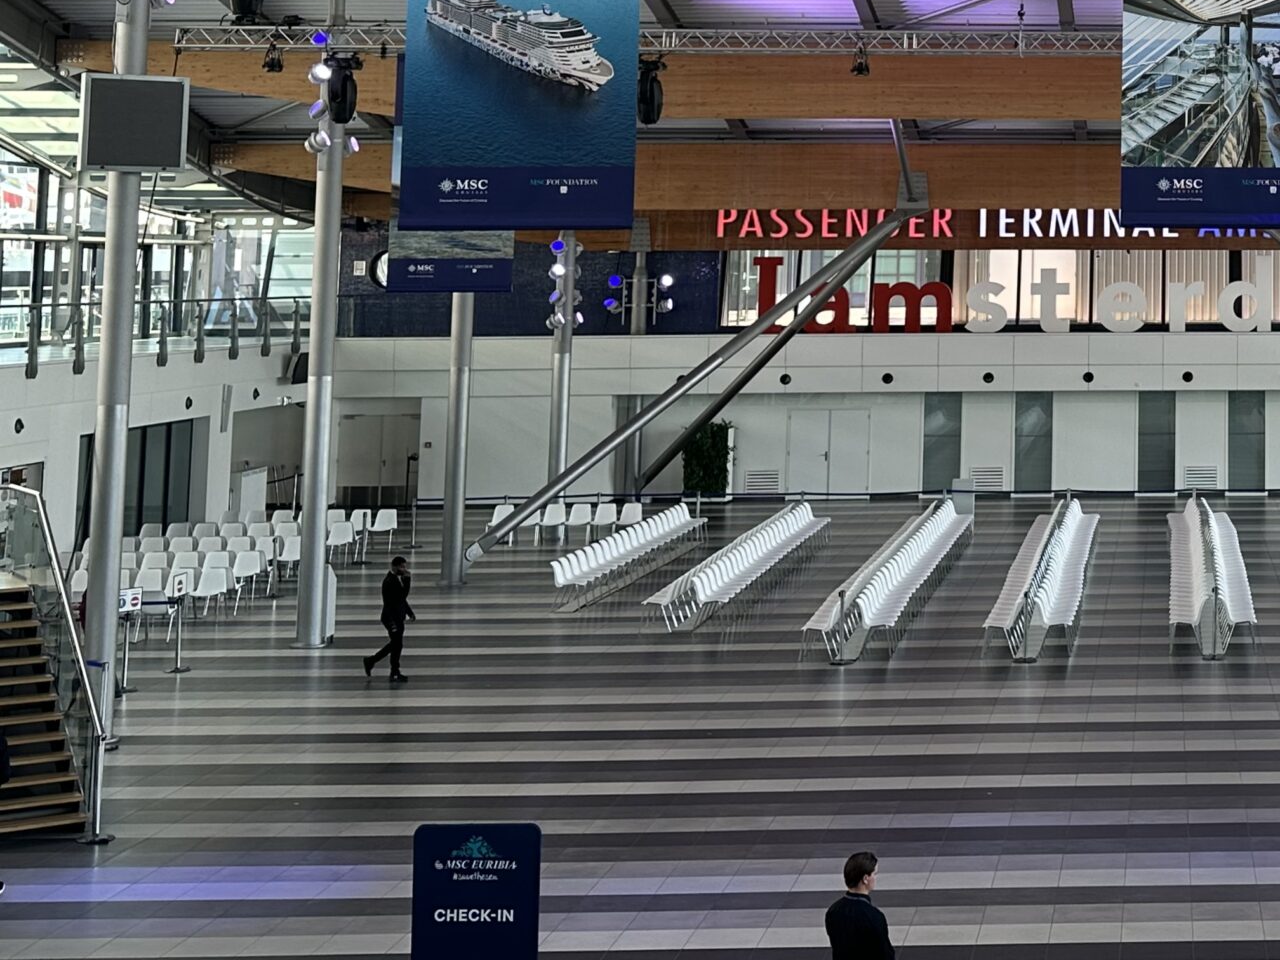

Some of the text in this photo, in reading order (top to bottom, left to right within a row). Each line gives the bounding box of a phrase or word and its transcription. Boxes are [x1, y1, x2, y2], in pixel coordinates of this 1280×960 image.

[456, 180, 488, 190] MSC
[1173, 179, 1203, 189] MSC
[980, 208, 1179, 238] TERMIN
[445, 860, 517, 870] MSC EURIBIA
[434, 909, 514, 922] CHECK-IN
